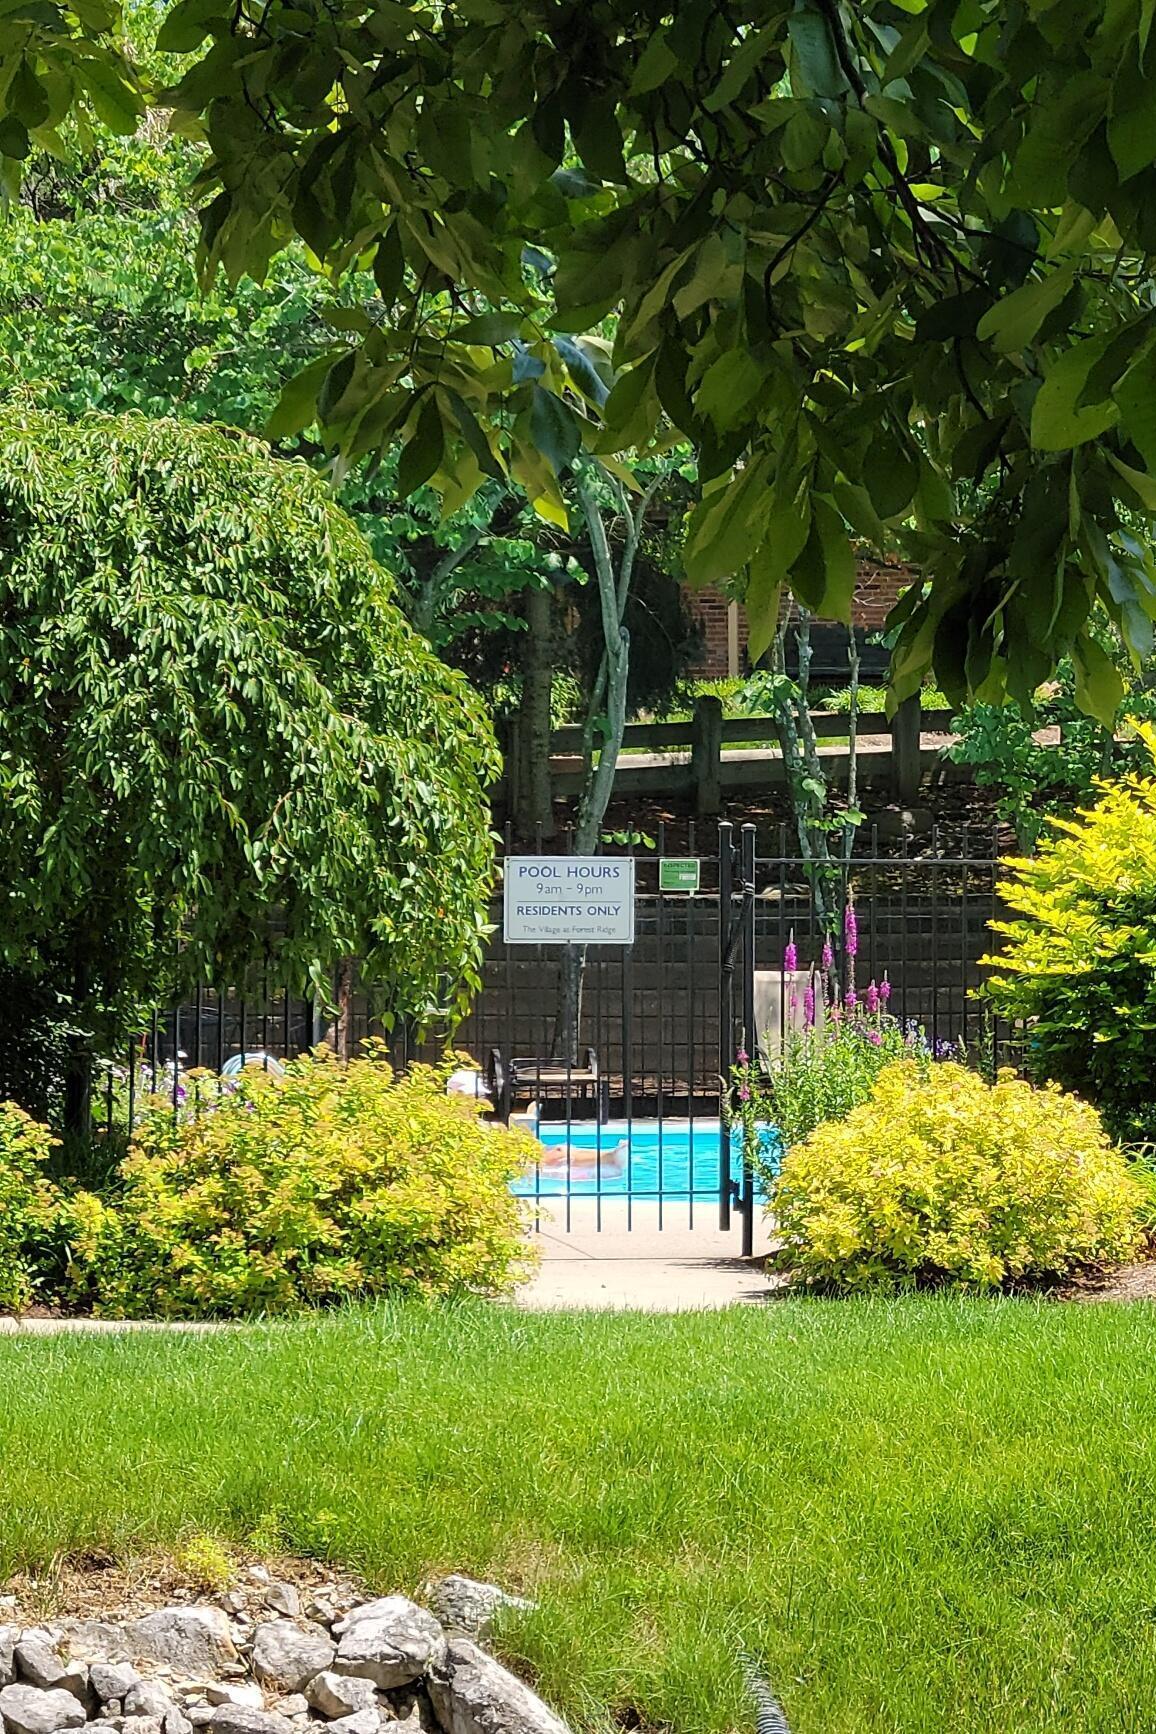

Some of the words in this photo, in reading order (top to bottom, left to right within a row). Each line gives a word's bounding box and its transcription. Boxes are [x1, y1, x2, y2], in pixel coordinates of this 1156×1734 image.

[518, 865, 561, 878] POOL
[567, 865, 620, 878] HOURS
[536, 882, 562, 894] 9am
[576, 882, 603, 897] 9pm
[516, 905, 582, 916] RESIDENTS
[587, 905, 621, 916] ONLY
[523, 925, 536, 933] The
[538, 925, 560, 935] Village
[597, 925, 616, 935] Ridge
